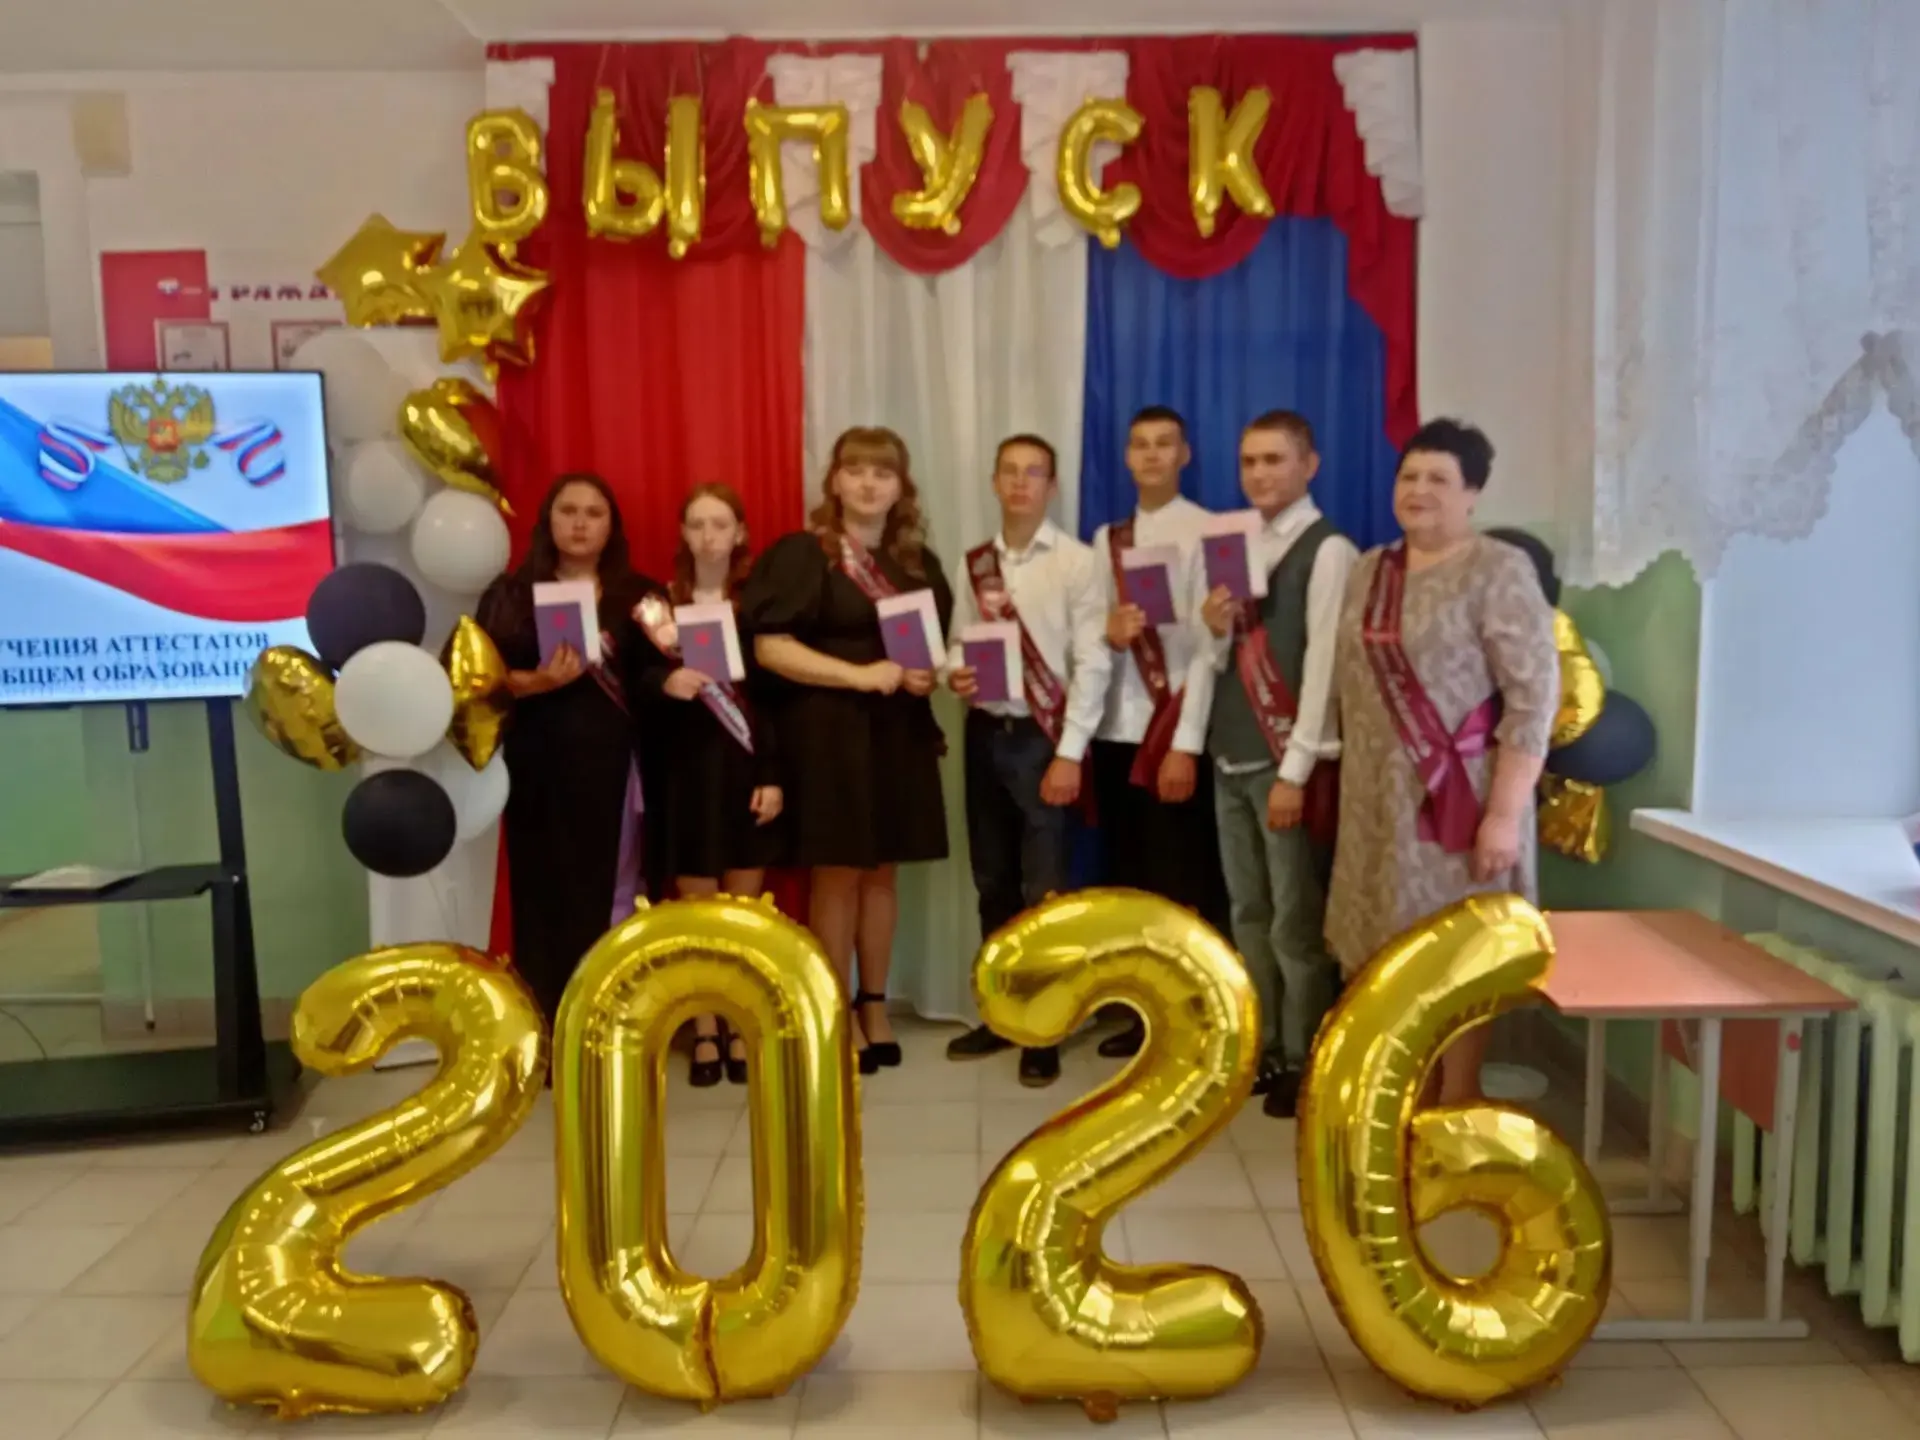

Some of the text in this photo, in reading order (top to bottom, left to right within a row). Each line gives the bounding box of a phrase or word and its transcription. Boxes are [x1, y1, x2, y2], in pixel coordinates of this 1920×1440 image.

[465, 86, 1275, 258] ВЫПУСК
[0, 631, 269, 657] ЧЕНИЯ АТТЕСТАТОВ
[187, 888, 1613, 1418] 2026
